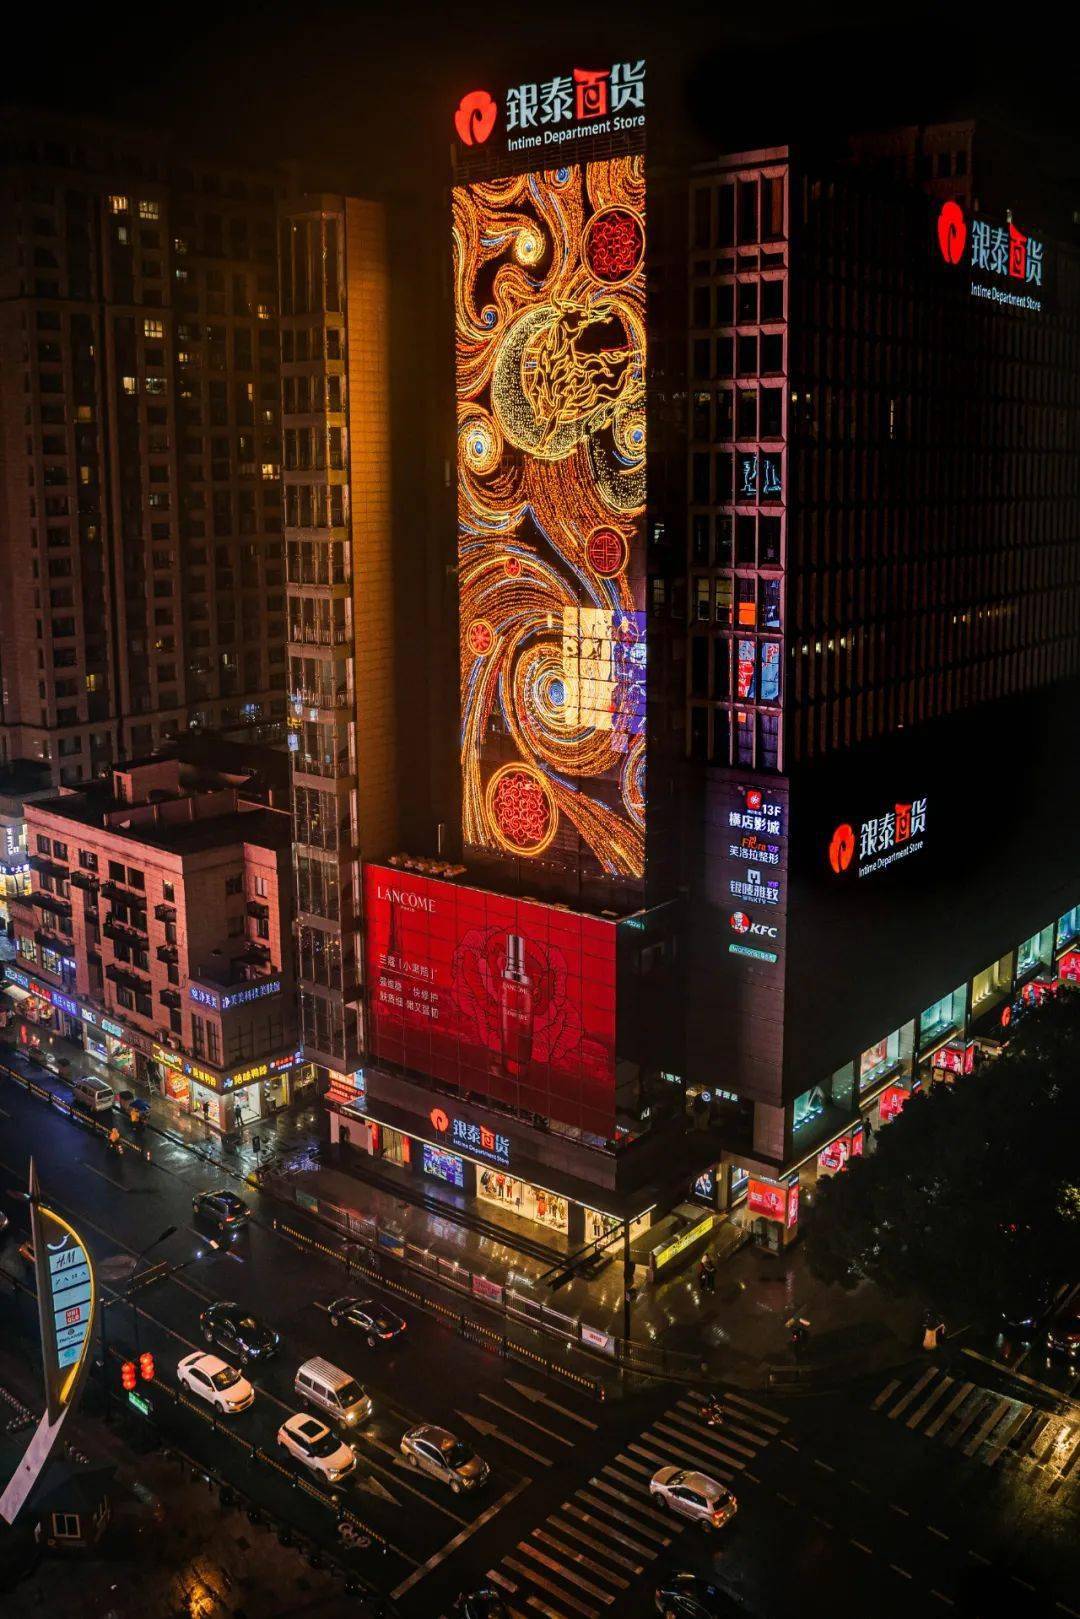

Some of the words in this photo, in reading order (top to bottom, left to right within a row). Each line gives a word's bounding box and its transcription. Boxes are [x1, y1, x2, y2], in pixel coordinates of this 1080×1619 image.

[506, 60, 646, 132] 银泰百货
[508, 135, 542, 152] Intime
[544, 121, 611, 145] Department
[613, 114, 646, 131] Store
[971, 219, 1044, 286] 银泰百货
[971, 281, 991, 299] Intime
[991, 286, 1026, 307] Department
[1026, 296, 1041, 312] Store
[729, 811, 780, 835] 横店影城
[761, 803, 782, 817] 13F
[859, 797, 927, 861] 银泰百货
[858, 862, 877, 878] Intime
[877, 846, 909, 868] Department
[909, 840, 924, 854] Store
[377, 886, 437, 914] LANCÔME
[749, 922, 778, 938] KFC
[453, 1118, 510, 1158] 银泰百货
[55, 1271, 87, 1285] ZARA
